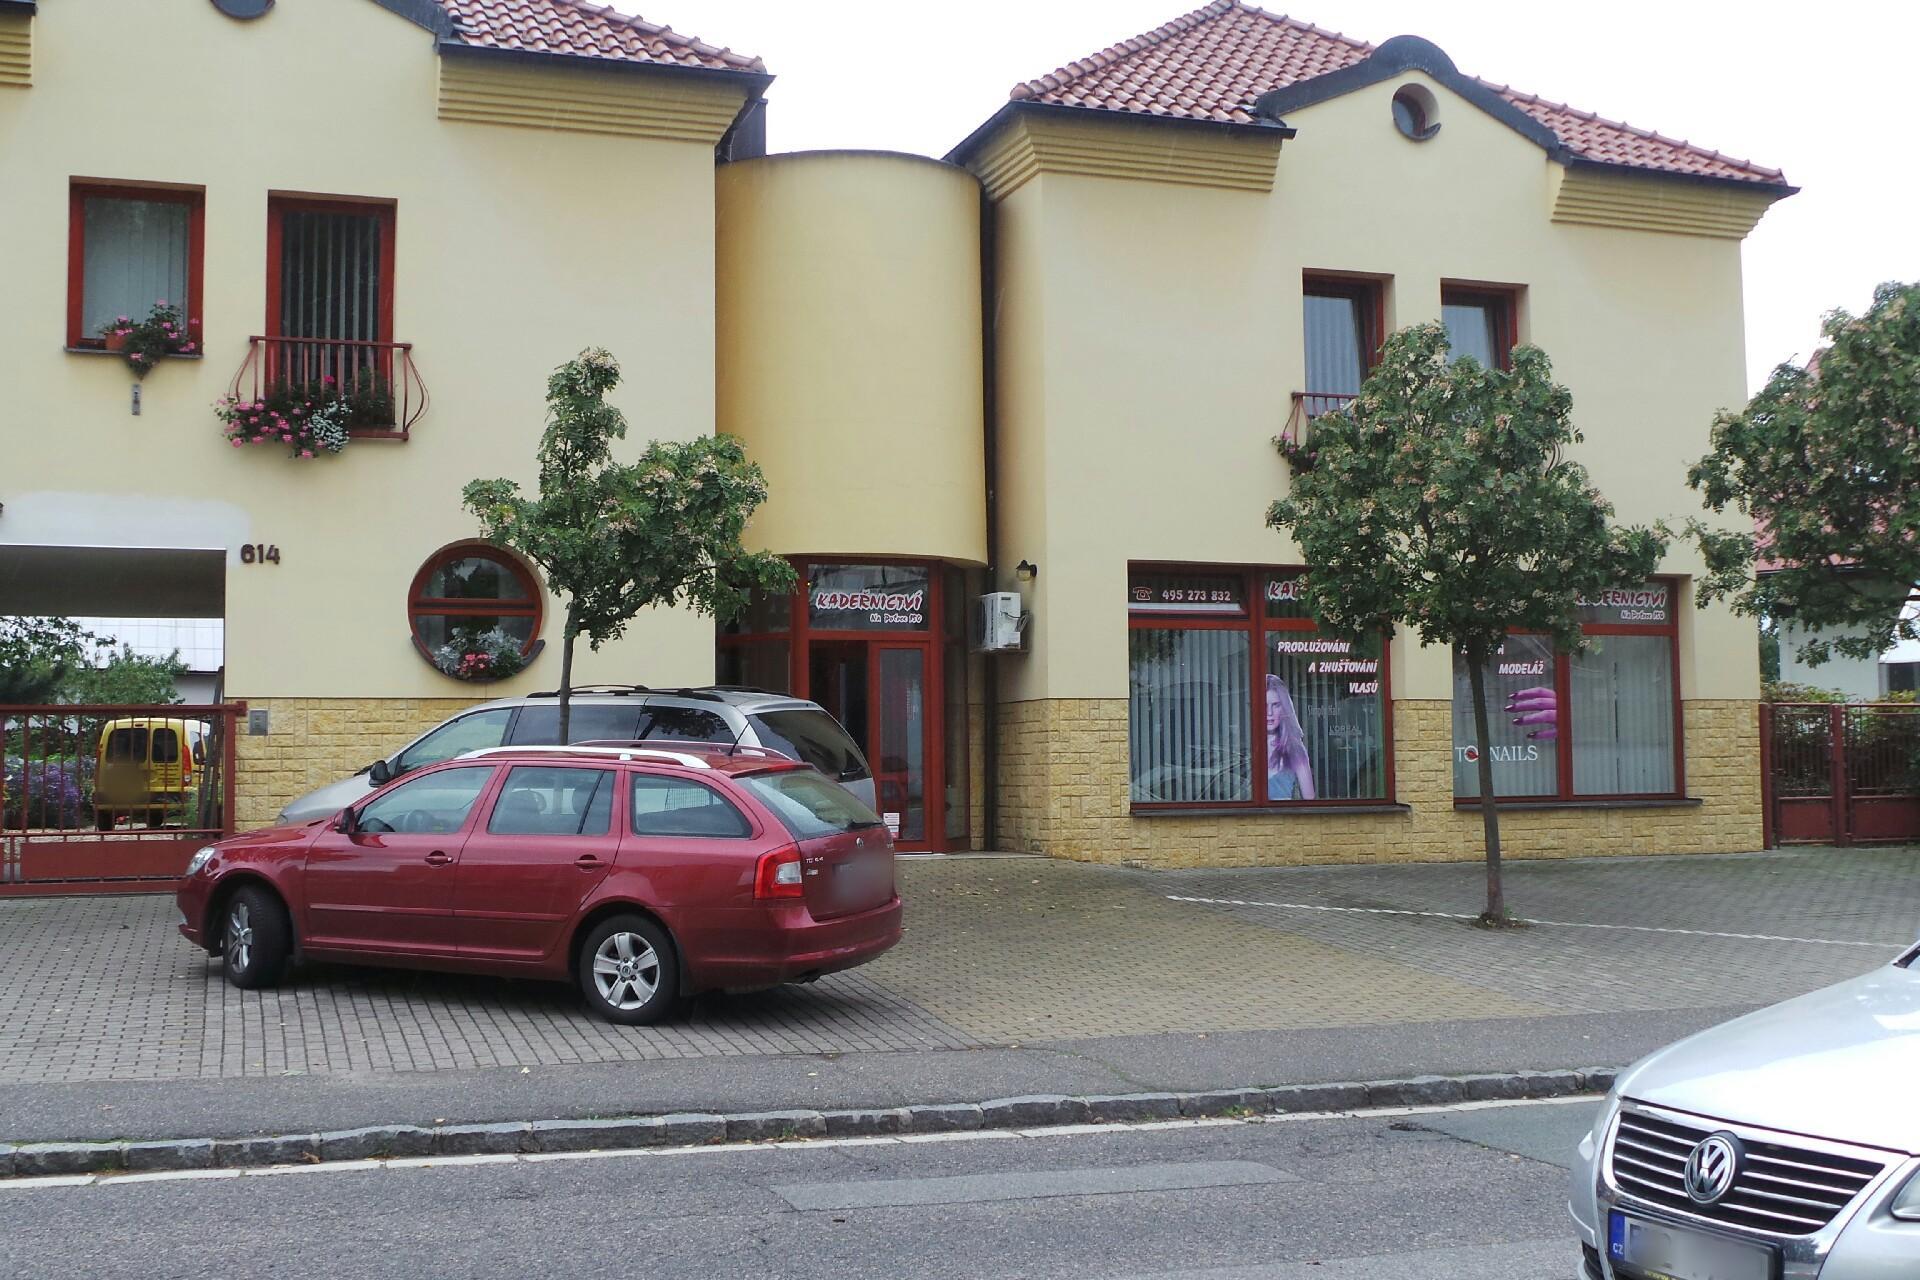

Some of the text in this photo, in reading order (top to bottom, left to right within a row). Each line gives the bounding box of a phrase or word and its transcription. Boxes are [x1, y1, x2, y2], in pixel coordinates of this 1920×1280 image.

[240, 544, 281, 565] 614
[815, 589, 923, 611] KADEŘNICTVÍ
[1162, 589, 1231, 601] 495 273 832
[1308, 662, 1316, 672] A
[1498, 661, 1544, 675] MODELÁŽ
[1489, 745, 1538, 762] NAILS
[1612, 1242, 1624, 1255] CZ
